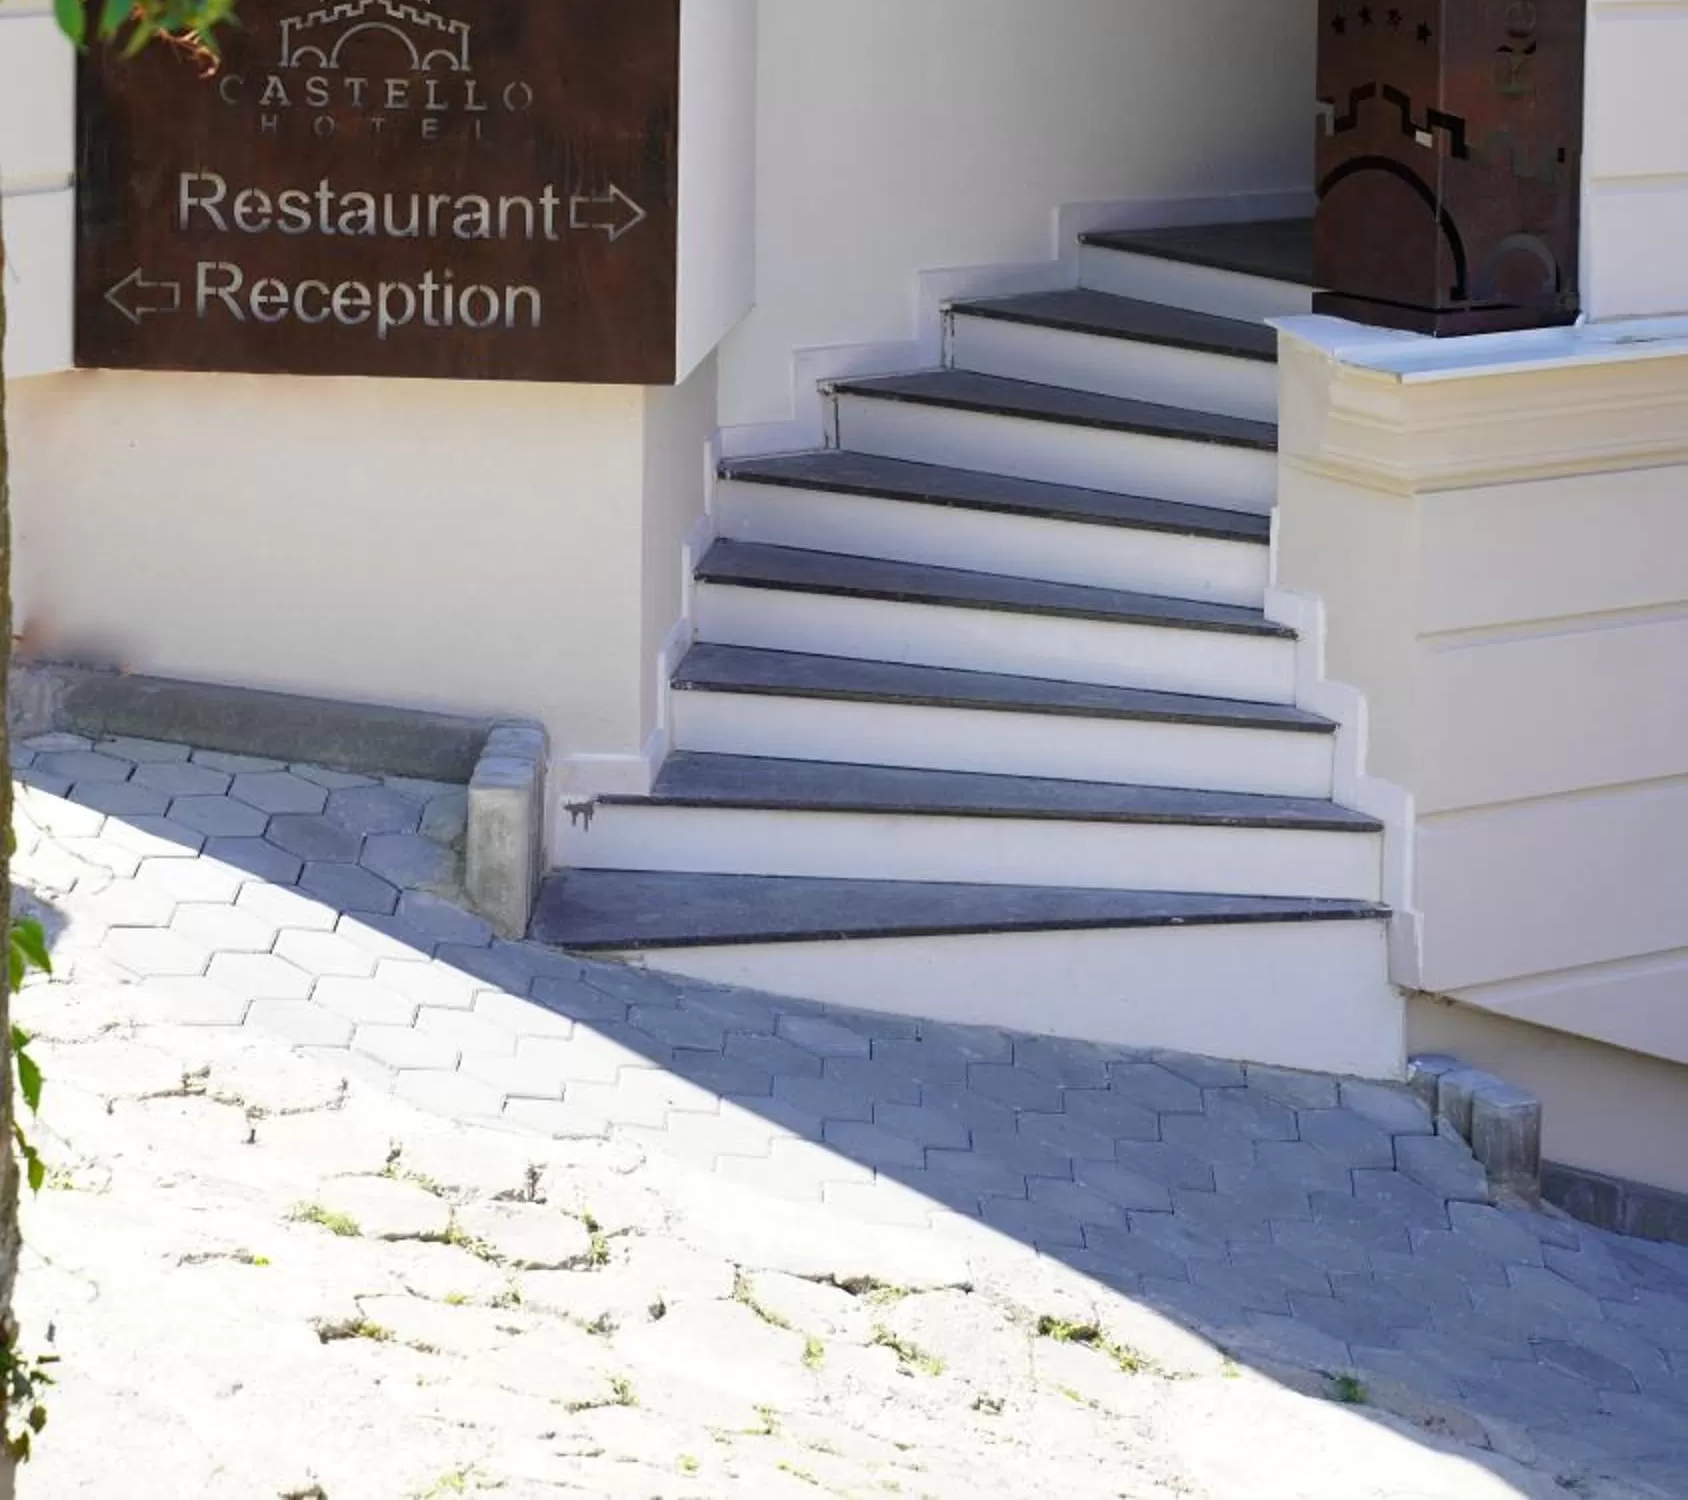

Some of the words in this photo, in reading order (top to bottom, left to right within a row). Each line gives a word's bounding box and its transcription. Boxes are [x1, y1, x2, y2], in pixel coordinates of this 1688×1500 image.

[218, 72, 534, 113] CASTELLO
[178, 171, 561, 242] Restaurant
[195, 260, 542, 339] Reception
